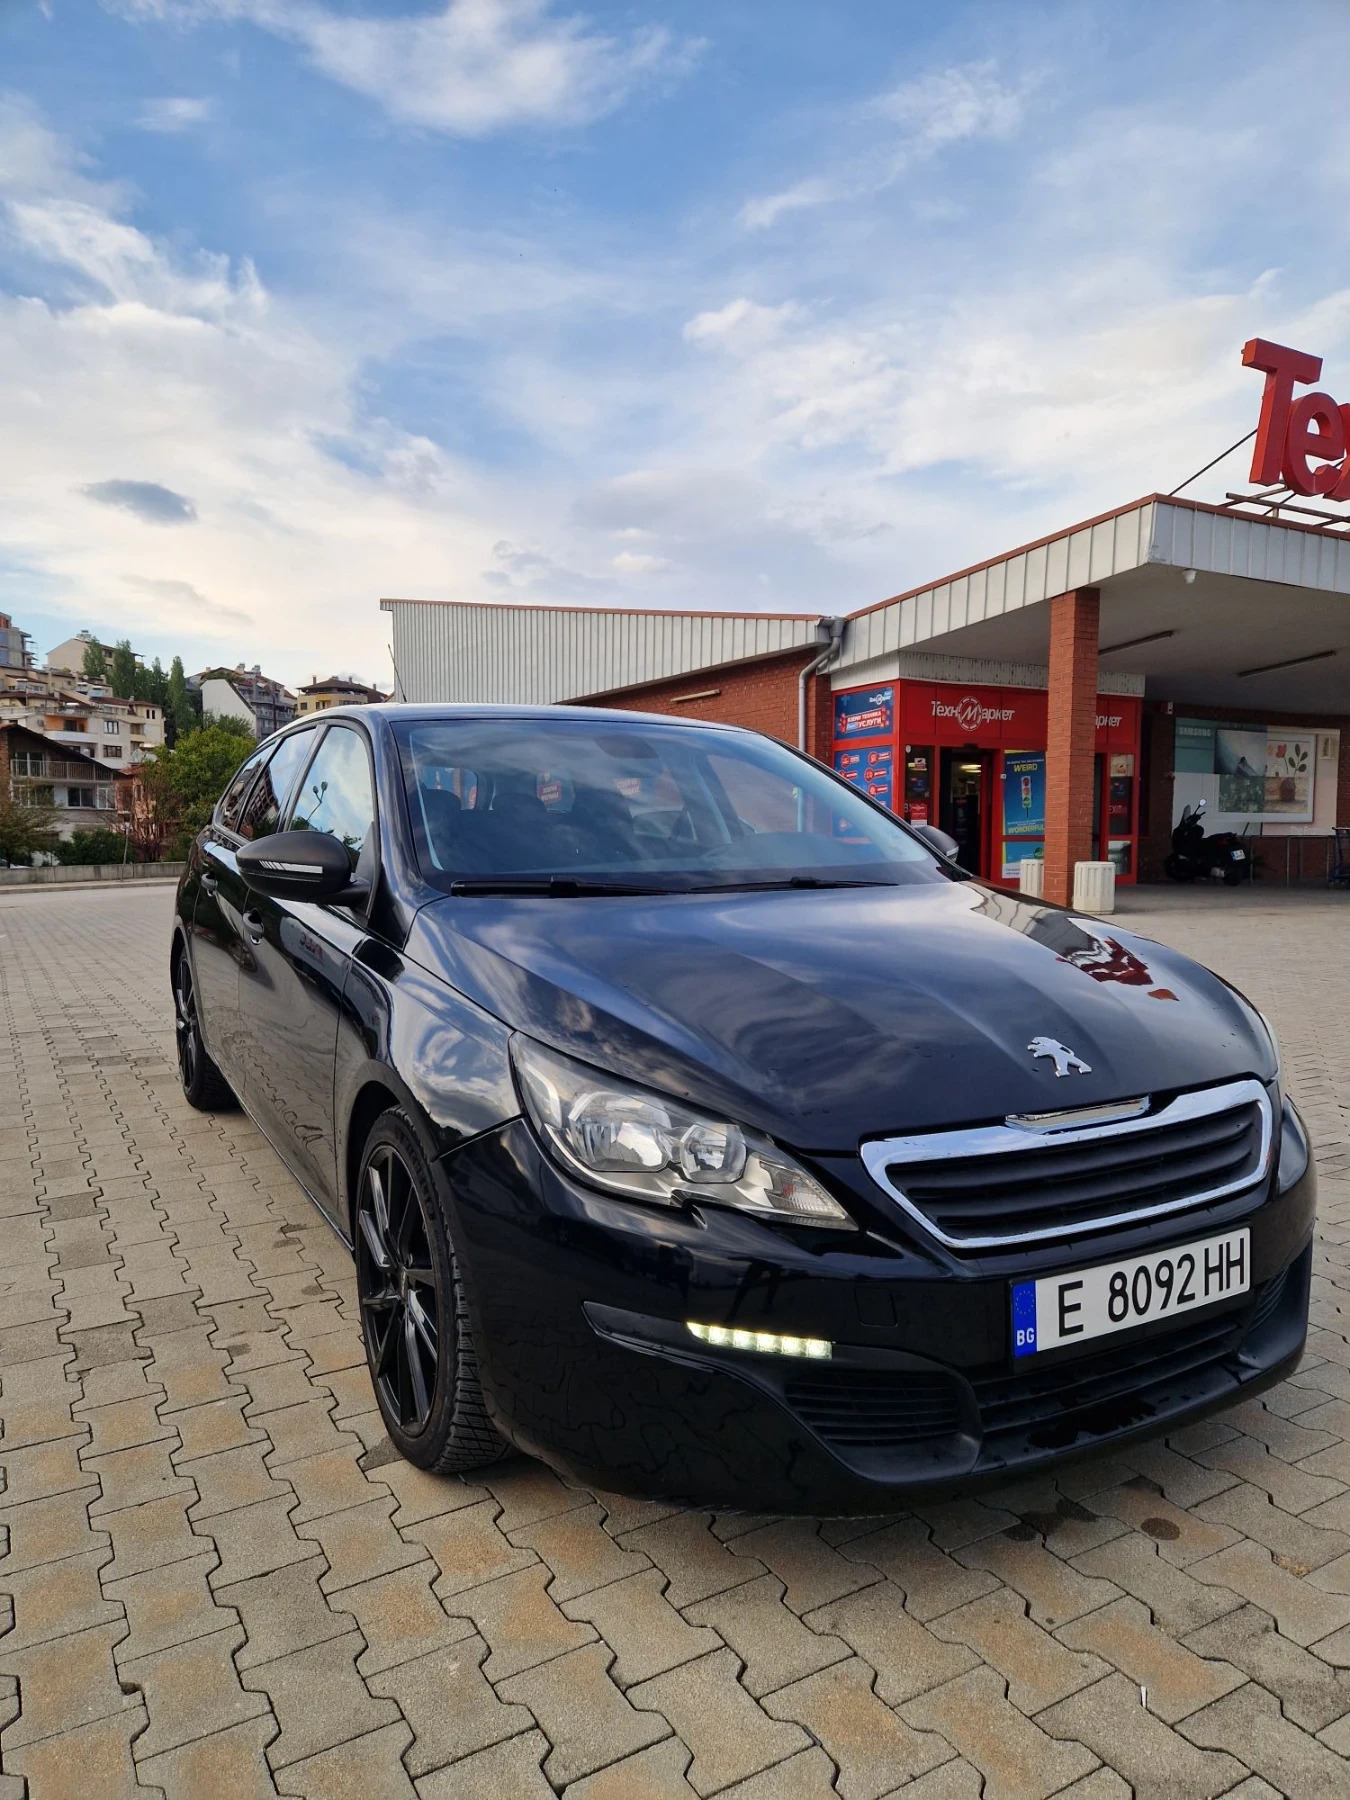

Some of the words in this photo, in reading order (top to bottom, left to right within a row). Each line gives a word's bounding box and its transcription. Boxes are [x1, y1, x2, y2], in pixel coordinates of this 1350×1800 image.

[1179, 726, 1212, 737] SAMSUNG
[1013, 763, 1038, 773] WEIRD
[1058, 1280, 1084, 1338] E
[1016, 1327, 1035, 1346] BG
